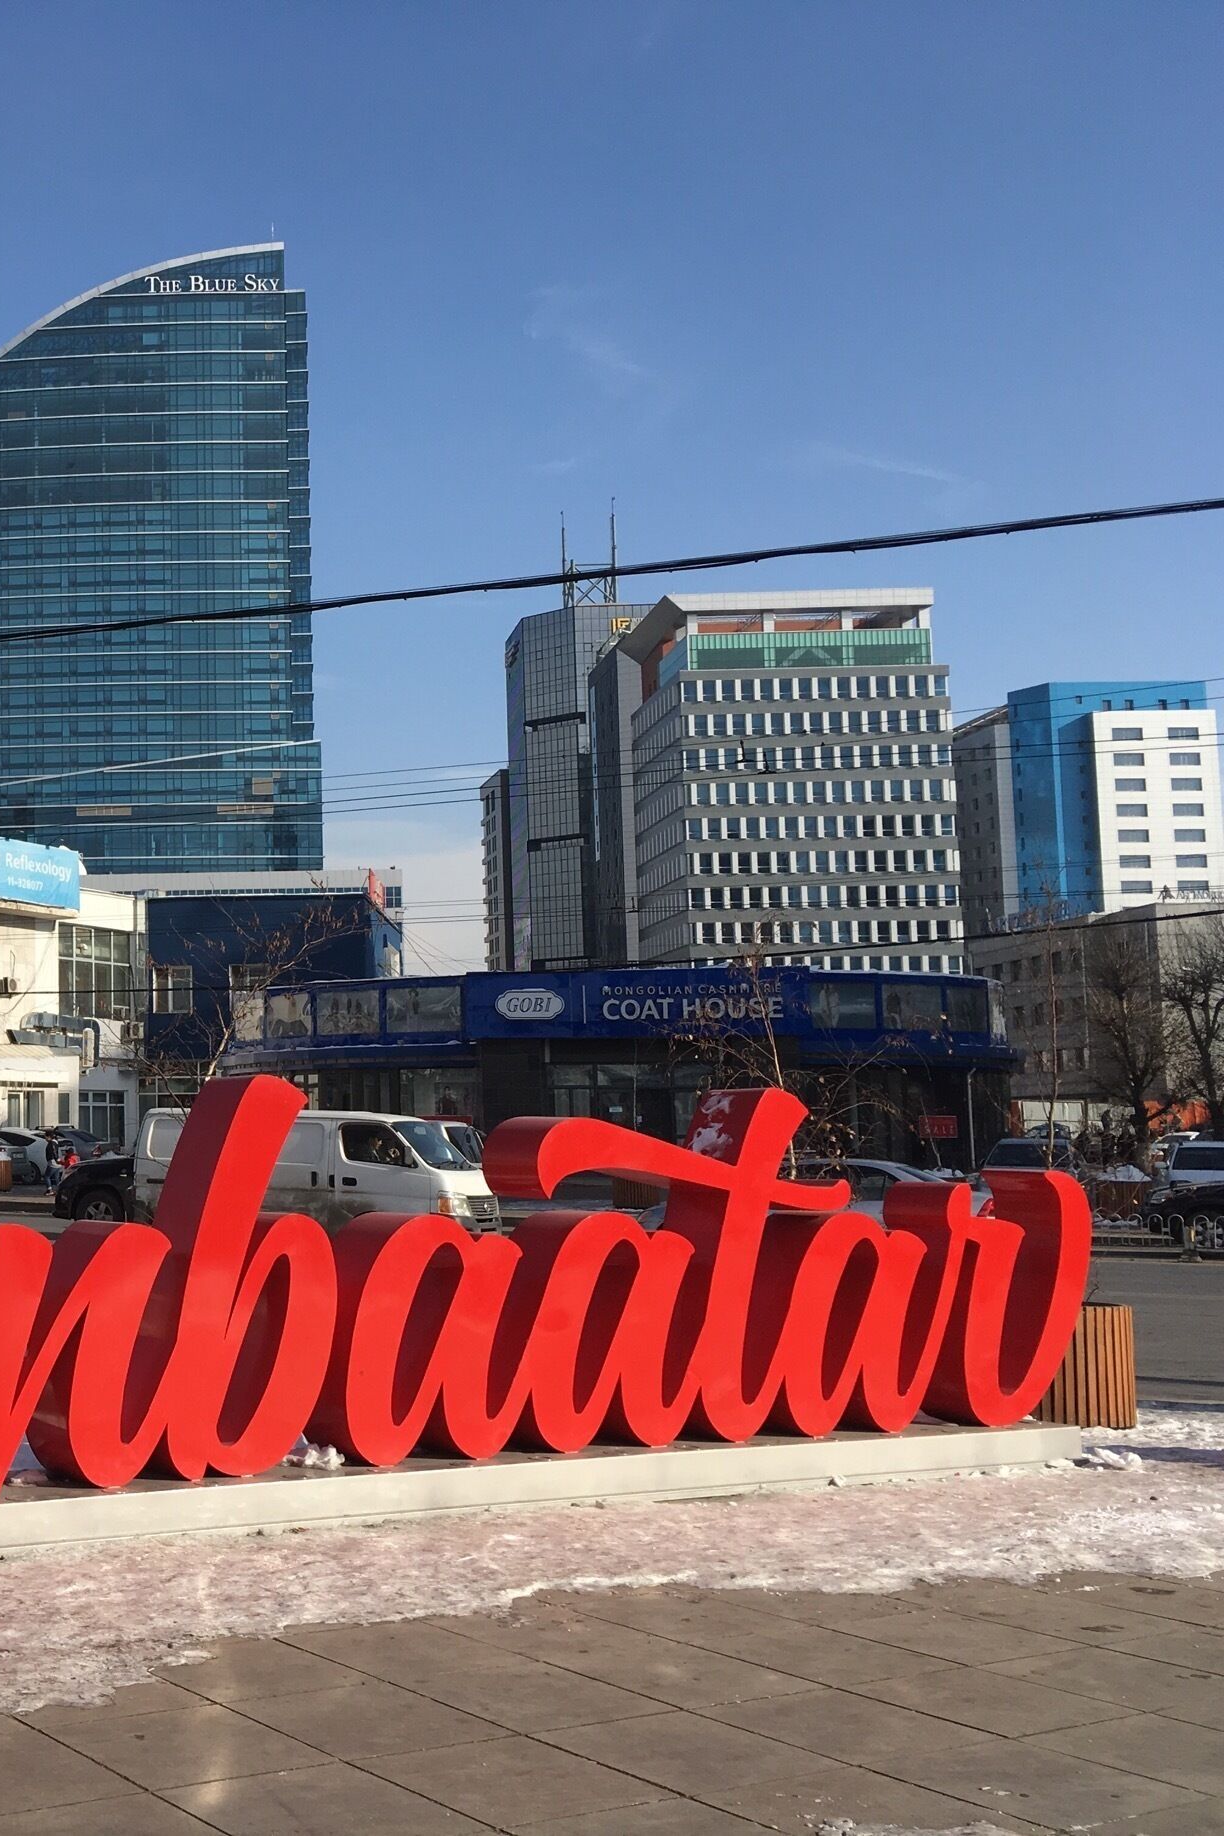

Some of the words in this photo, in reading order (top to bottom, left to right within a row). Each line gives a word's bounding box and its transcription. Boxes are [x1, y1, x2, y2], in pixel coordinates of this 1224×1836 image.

[144, 276, 181, 293] THE
[189, 275, 237, 292] BLUE
[244, 273, 280, 291] SKY
[5, 852, 72, 882] Reflexology
[602, 985, 693, 996] MONGOLIAN
[506, 997, 552, 1014] GOBI
[602, 998, 674, 1021] COAT
[682, 997, 785, 1020] HOUSE
